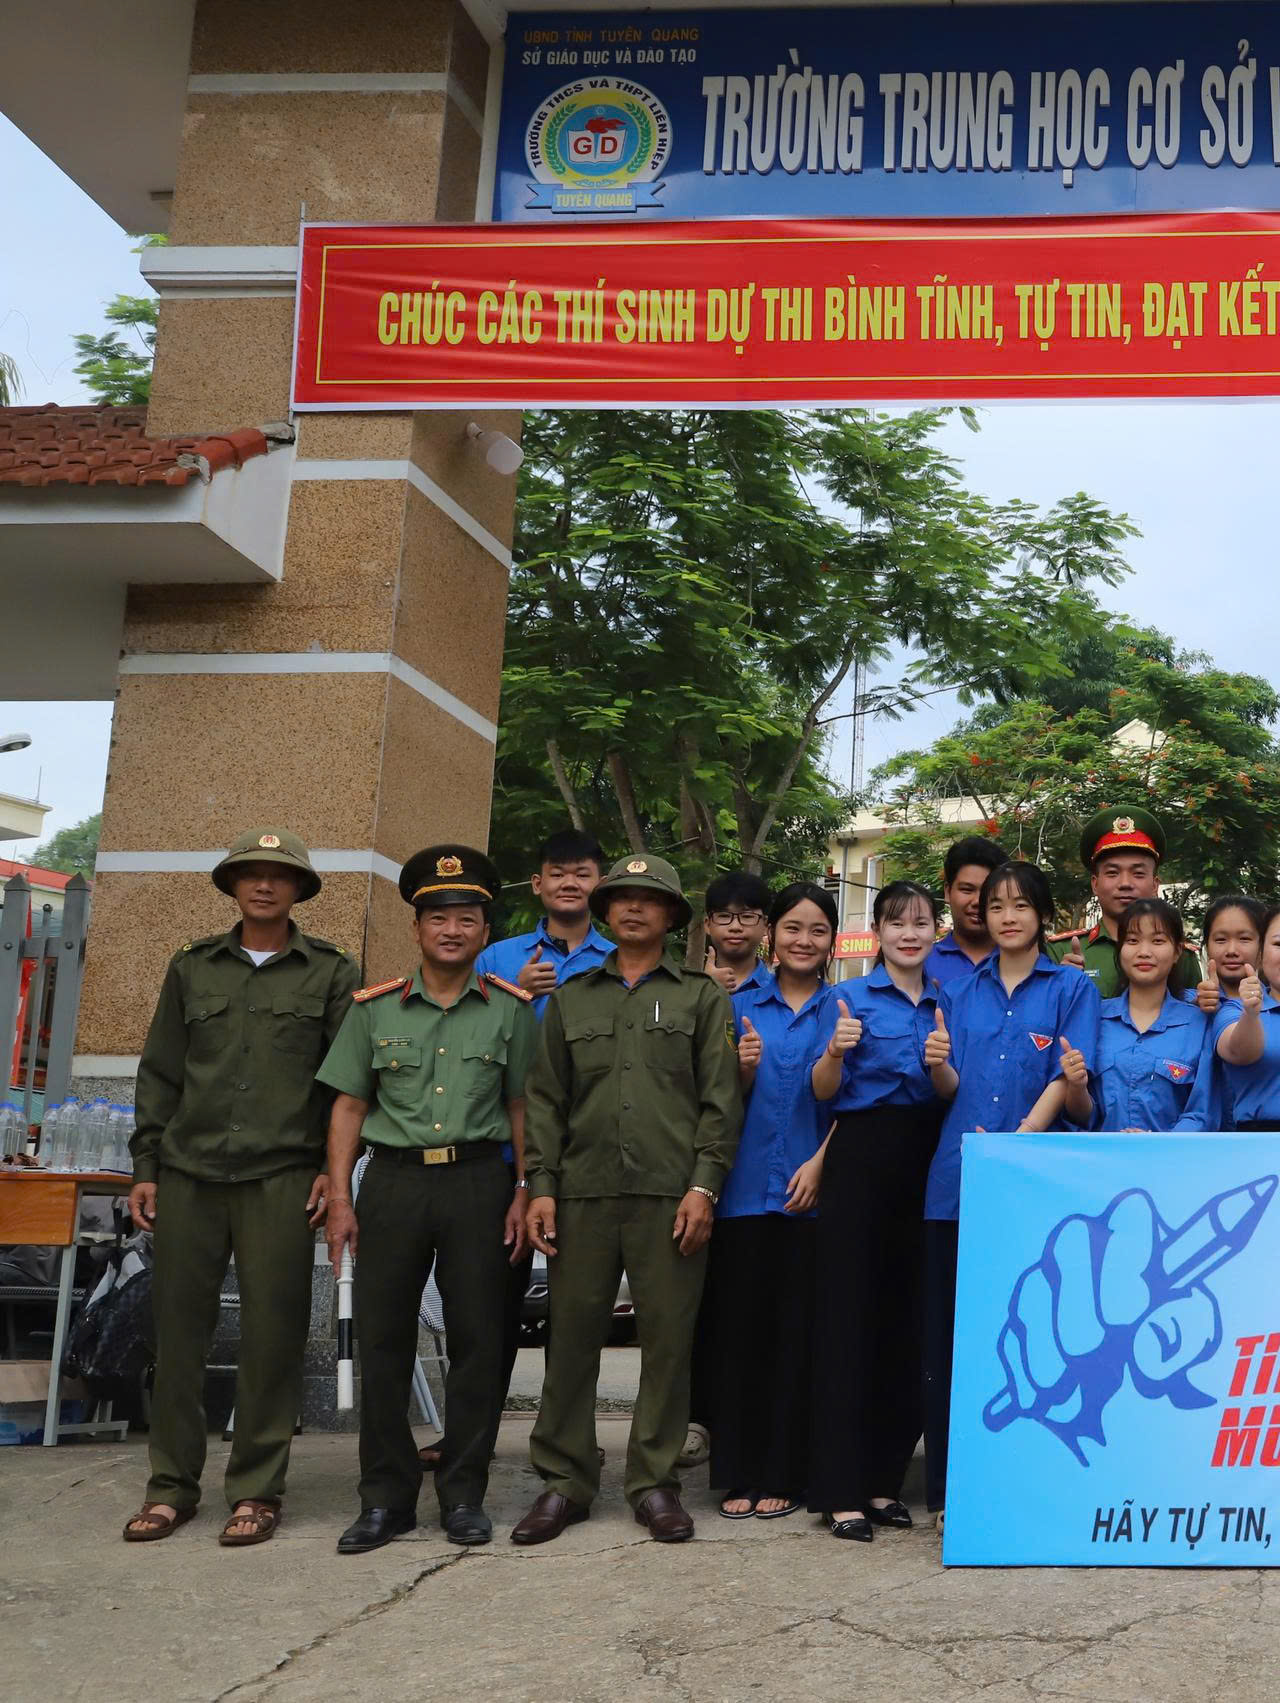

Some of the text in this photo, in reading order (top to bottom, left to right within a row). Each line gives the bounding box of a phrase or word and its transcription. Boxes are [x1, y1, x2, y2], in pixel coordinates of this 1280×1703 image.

[524, 26, 699, 43] UBND TỈNH TUYÊN QUANG
[522, 47, 696, 67] SỞ GIÁO DỤC VÀ ĐÀO TẠO
[546, 83, 584, 108] THCS
[615, 80, 652, 102] THPT
[702, 49, 863, 174] TRƯỜNG
[880, 70, 1013, 171] TRUNG
[1028, 68, 1109, 187] HỌC
[1127, 59, 1184, 168] CƠ
[1200, 39, 1256, 167] SỞ
[556, 193, 633, 207] TUYÊN QUANG
[379, 281, 465, 344] CHÚC
[478, 281, 542, 344] CÁC
[555, 280, 604, 342] THÍ
[616, 290, 695, 343] SINH
[707, 281, 754, 352] DỰ
[762, 288, 812, 340] THI
[825, 276, 904, 340] BÌNH
[917, 276, 1002, 344] TĨNH,
[1016, 280, 1059, 350] TỰ
[1067, 284, 1131, 345] TIN,
[1143, 283, 1207, 348] ĐẠT
[1220, 264, 1280, 335] KẾT
[841, 938, 873, 953] SINH
[1092, 1501, 1158, 1542] HÃY
[1169, 1504, 1210, 1549] TỰ
[1220, 1508, 1270, 1547] TIN,
